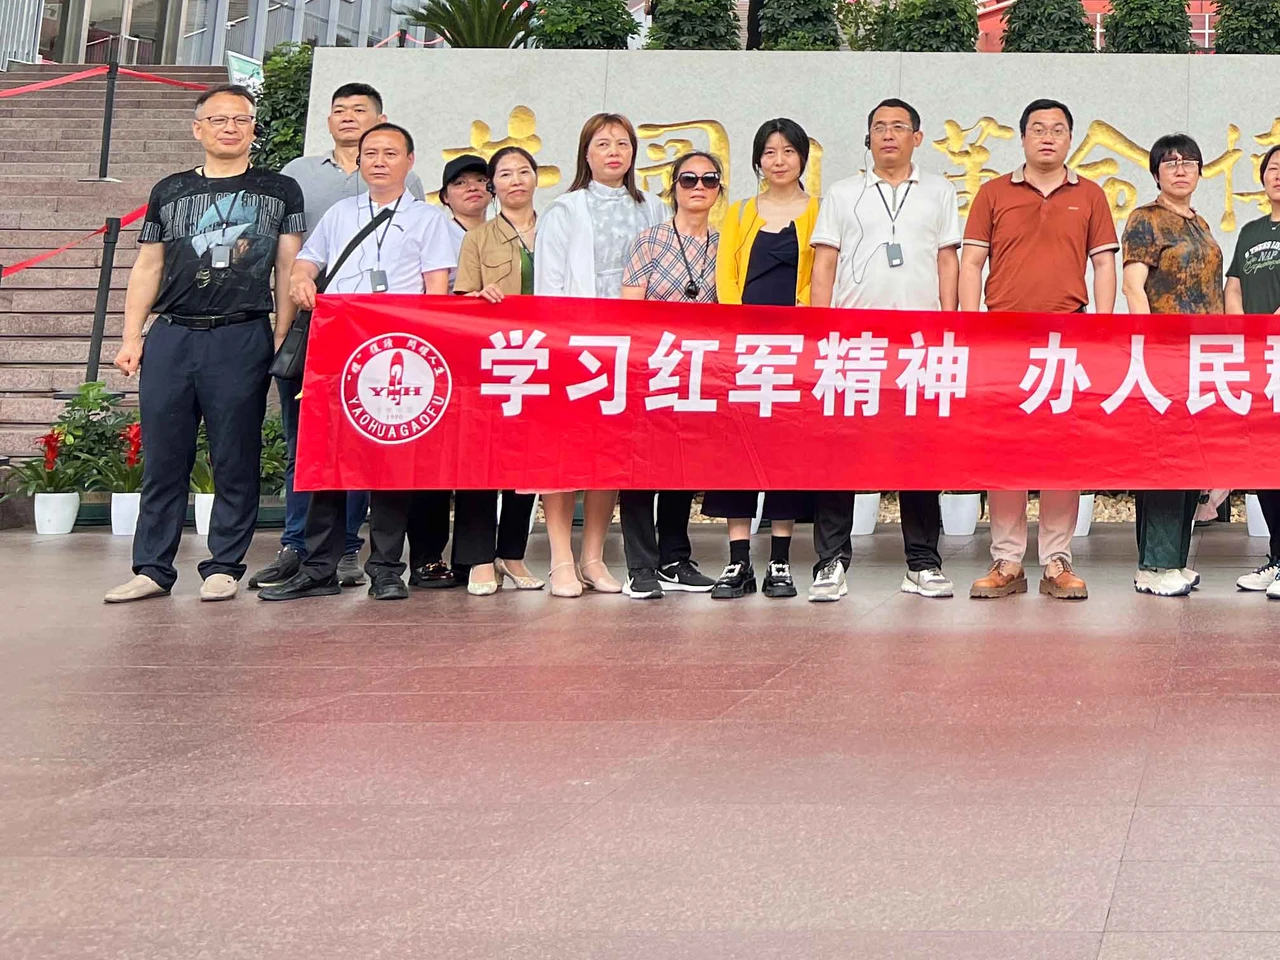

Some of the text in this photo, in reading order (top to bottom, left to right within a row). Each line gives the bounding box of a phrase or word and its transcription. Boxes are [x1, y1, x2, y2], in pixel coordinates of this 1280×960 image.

[481, 329, 969, 417] 学习红军精神
